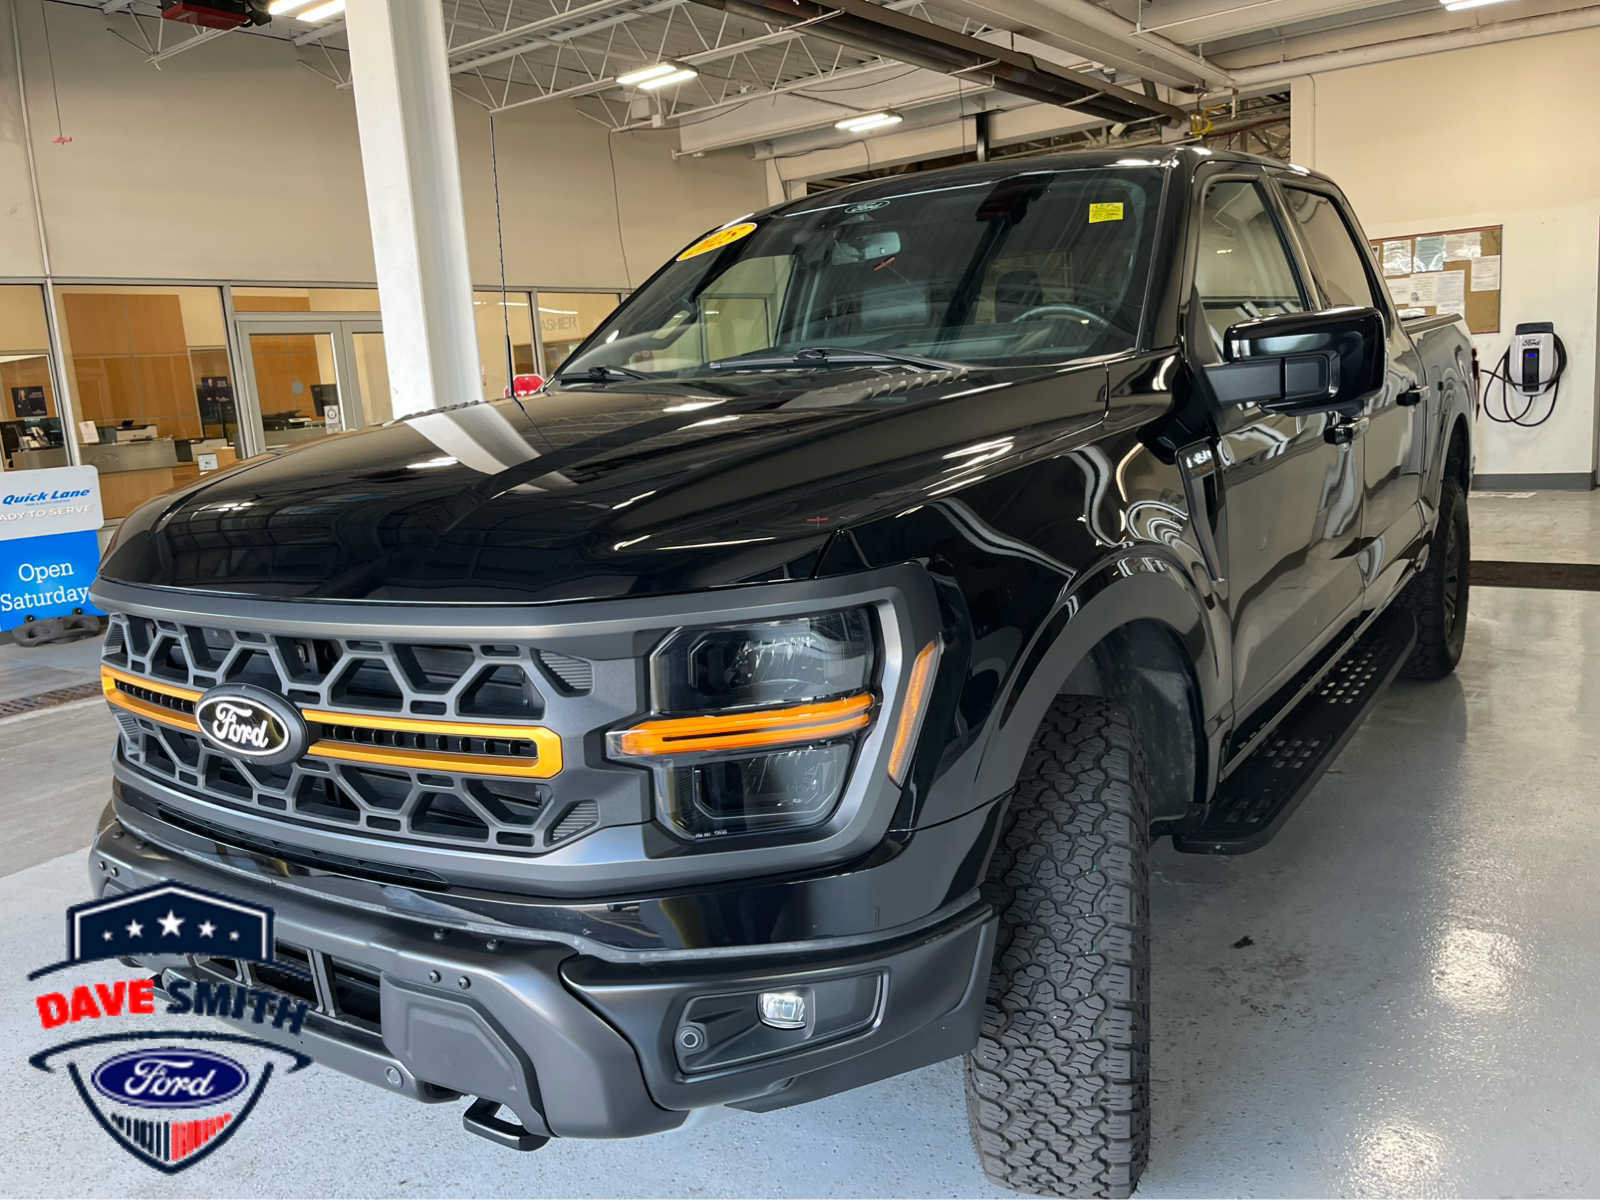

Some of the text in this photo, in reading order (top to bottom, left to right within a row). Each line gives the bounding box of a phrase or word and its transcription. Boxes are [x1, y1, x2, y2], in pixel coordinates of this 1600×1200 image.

[2, 491, 48, 505] Quick
[50, 489, 90, 500] Lane
[29, 509, 46, 518] TO
[18, 563, 75, 584] Open
[0, 585, 89, 612] Saturday
[213, 703, 269, 748] Ford
